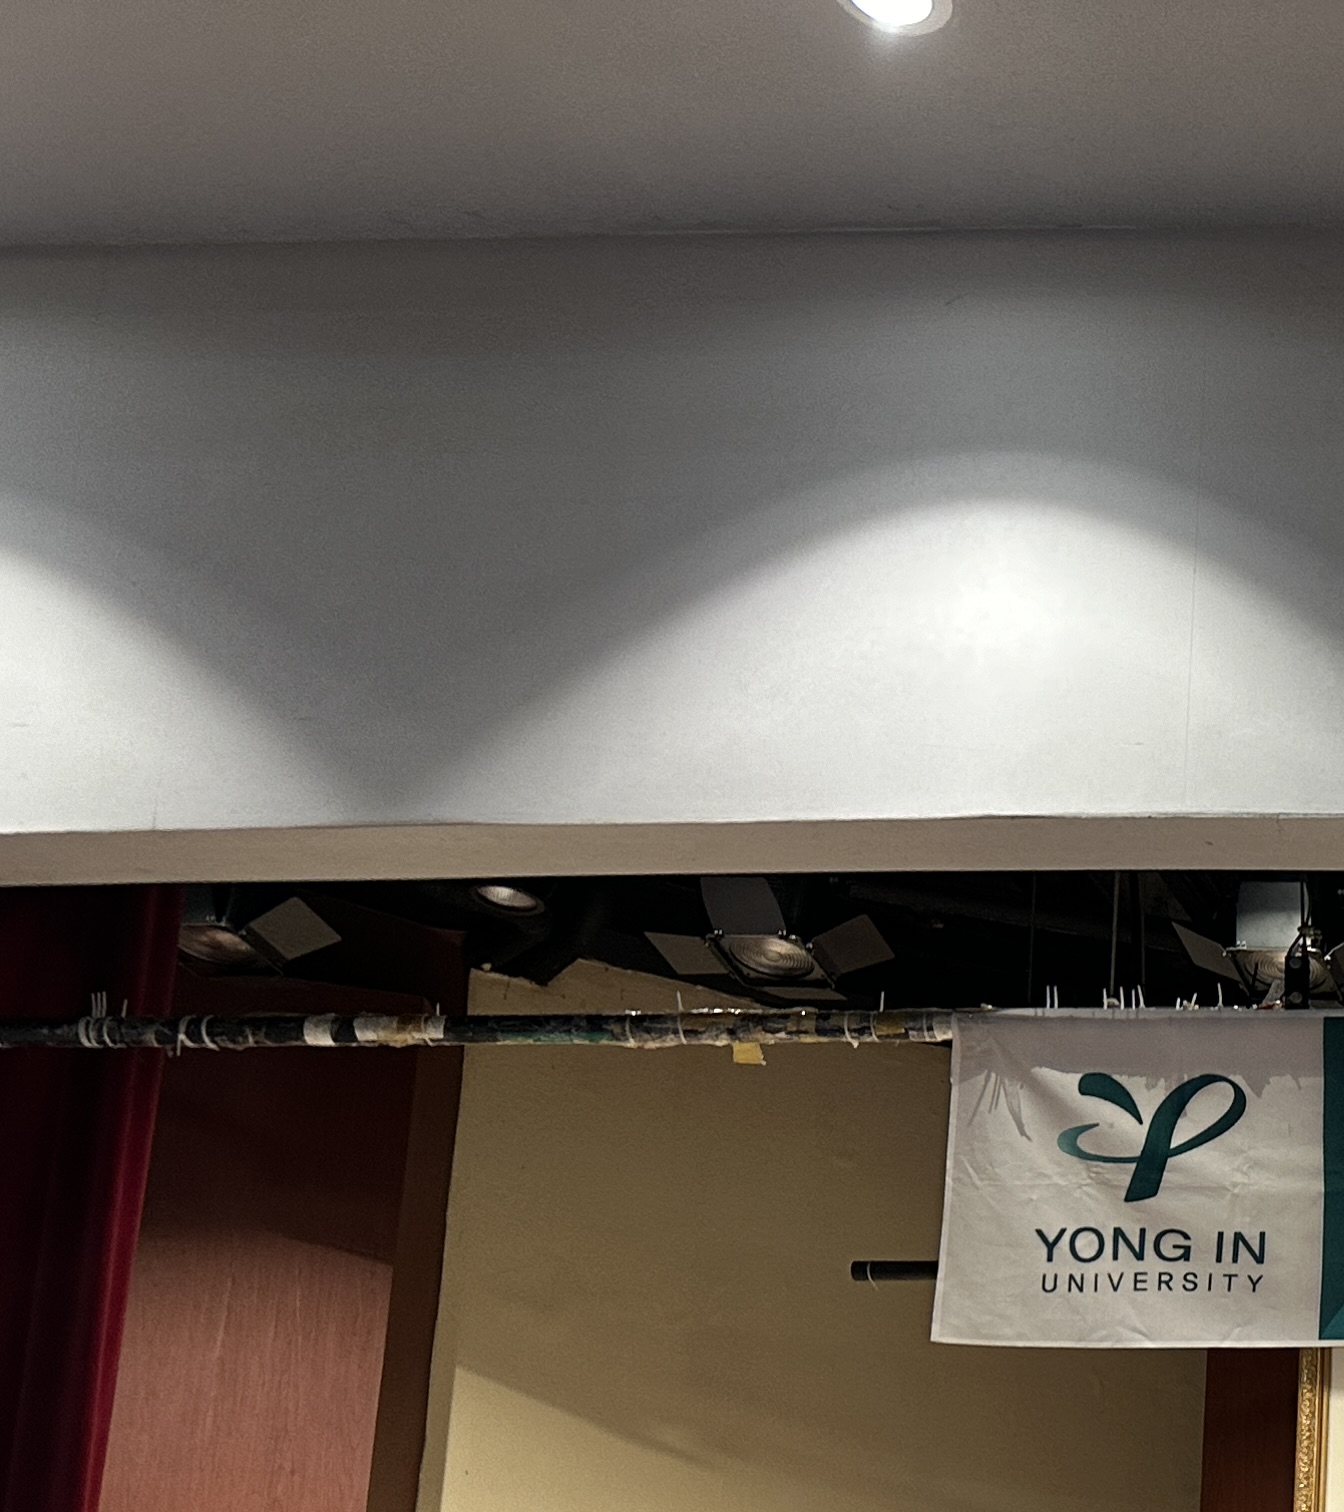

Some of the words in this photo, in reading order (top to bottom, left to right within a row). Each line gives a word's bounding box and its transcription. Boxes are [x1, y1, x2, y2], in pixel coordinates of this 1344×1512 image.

[1035, 1226, 1192, 1264] YONG
[1215, 1230, 1267, 1264] IN
[1041, 1271, 1265, 1294] UNIVERSITY
